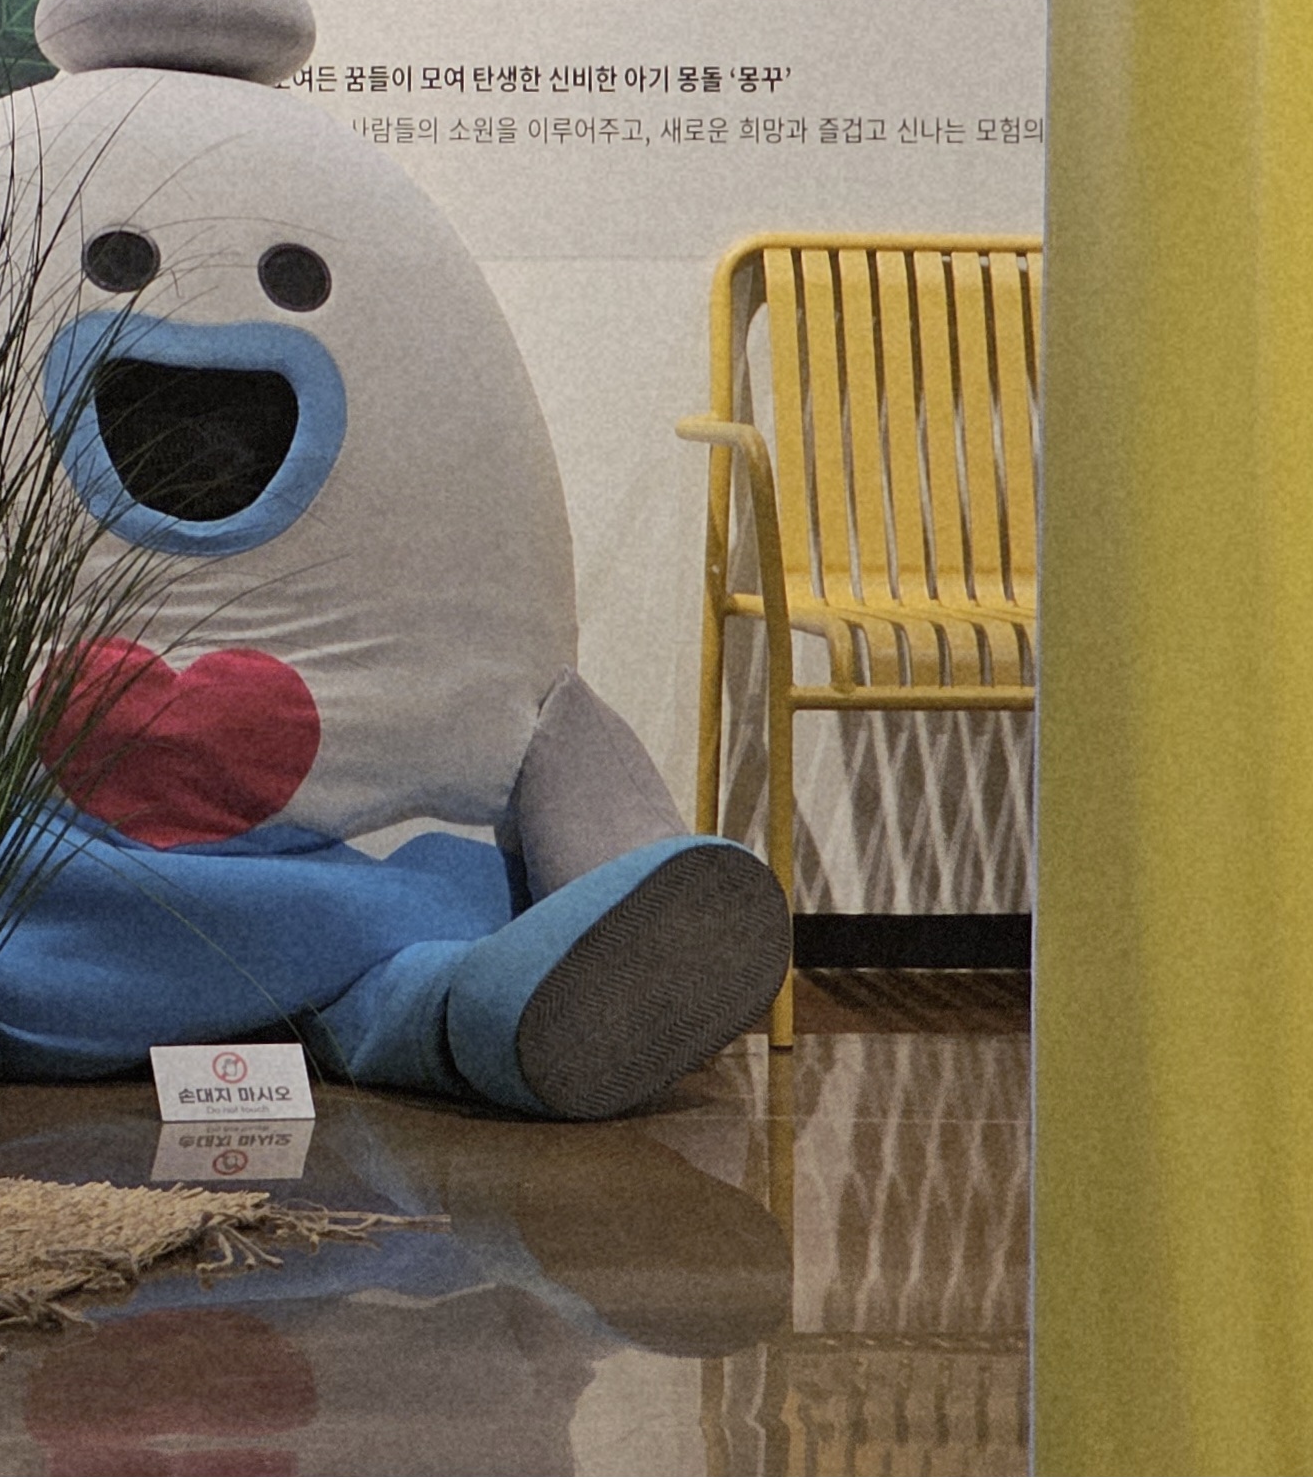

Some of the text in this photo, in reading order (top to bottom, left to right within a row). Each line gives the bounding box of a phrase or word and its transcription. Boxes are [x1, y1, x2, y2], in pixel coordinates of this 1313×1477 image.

[344, 64, 413, 94] 꿈들이
[420, 64, 466, 94] 모여
[472, 65, 542, 94] 탄생한
[549, 65, 618, 94] 신비한
[623, 64, 670, 94] 아기
[678, 65, 723, 94] 몽돌
[448, 116, 518, 145] 소원을
[527, 116, 652, 147] 이루어주고,
[660, 116, 729, 145] 새로운
[739, 116, 809, 145] 희망과
[818, 116, 887, 145] 즐겁고
[897, 116, 966, 145] 신나는
[976, 116, 1044, 145] 모험의
[178, 1085, 293, 1104] 손대지 마시오
[205, 1105, 220, 1115] Do
